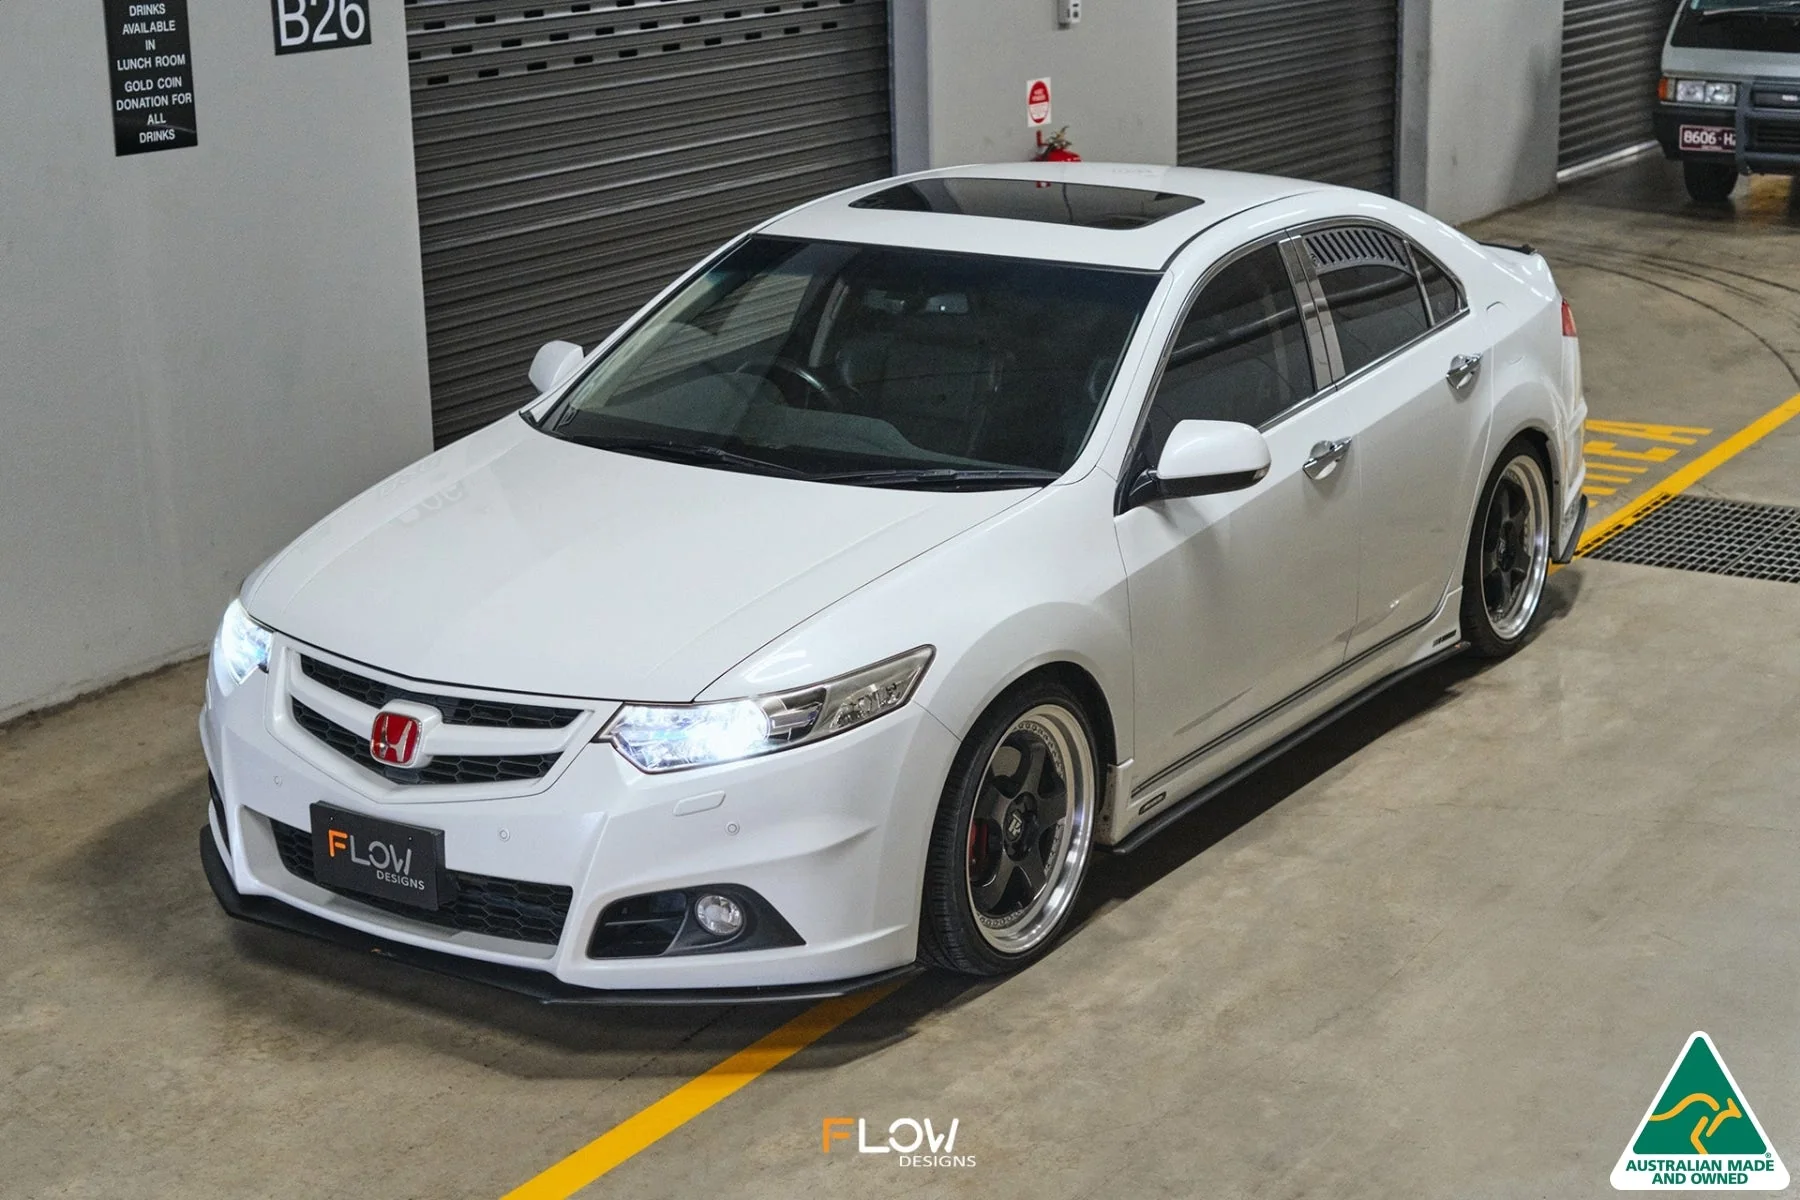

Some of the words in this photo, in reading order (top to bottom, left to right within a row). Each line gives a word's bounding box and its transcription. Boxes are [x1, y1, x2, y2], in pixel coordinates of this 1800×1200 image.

[129, 4, 166, 17] DRINKS
[122, 20, 176, 36] AVAILABLE
[278, 0, 366, 47] B26
[145, 39, 156, 51] IN
[117, 58, 152, 71] LUNCH
[155, 54, 186, 67] ROOM
[124, 80, 154, 92] GOLD
[157, 76, 182, 89] COIN
[116, 95, 169, 111] DONATION
[172, 93, 192, 106] FOR
[147, 114, 166, 126] ALL
[139, 129, 176, 144] DRINKS
[327, 829, 412, 876] FLOW
[376, 870, 426, 890] DESIGNS
